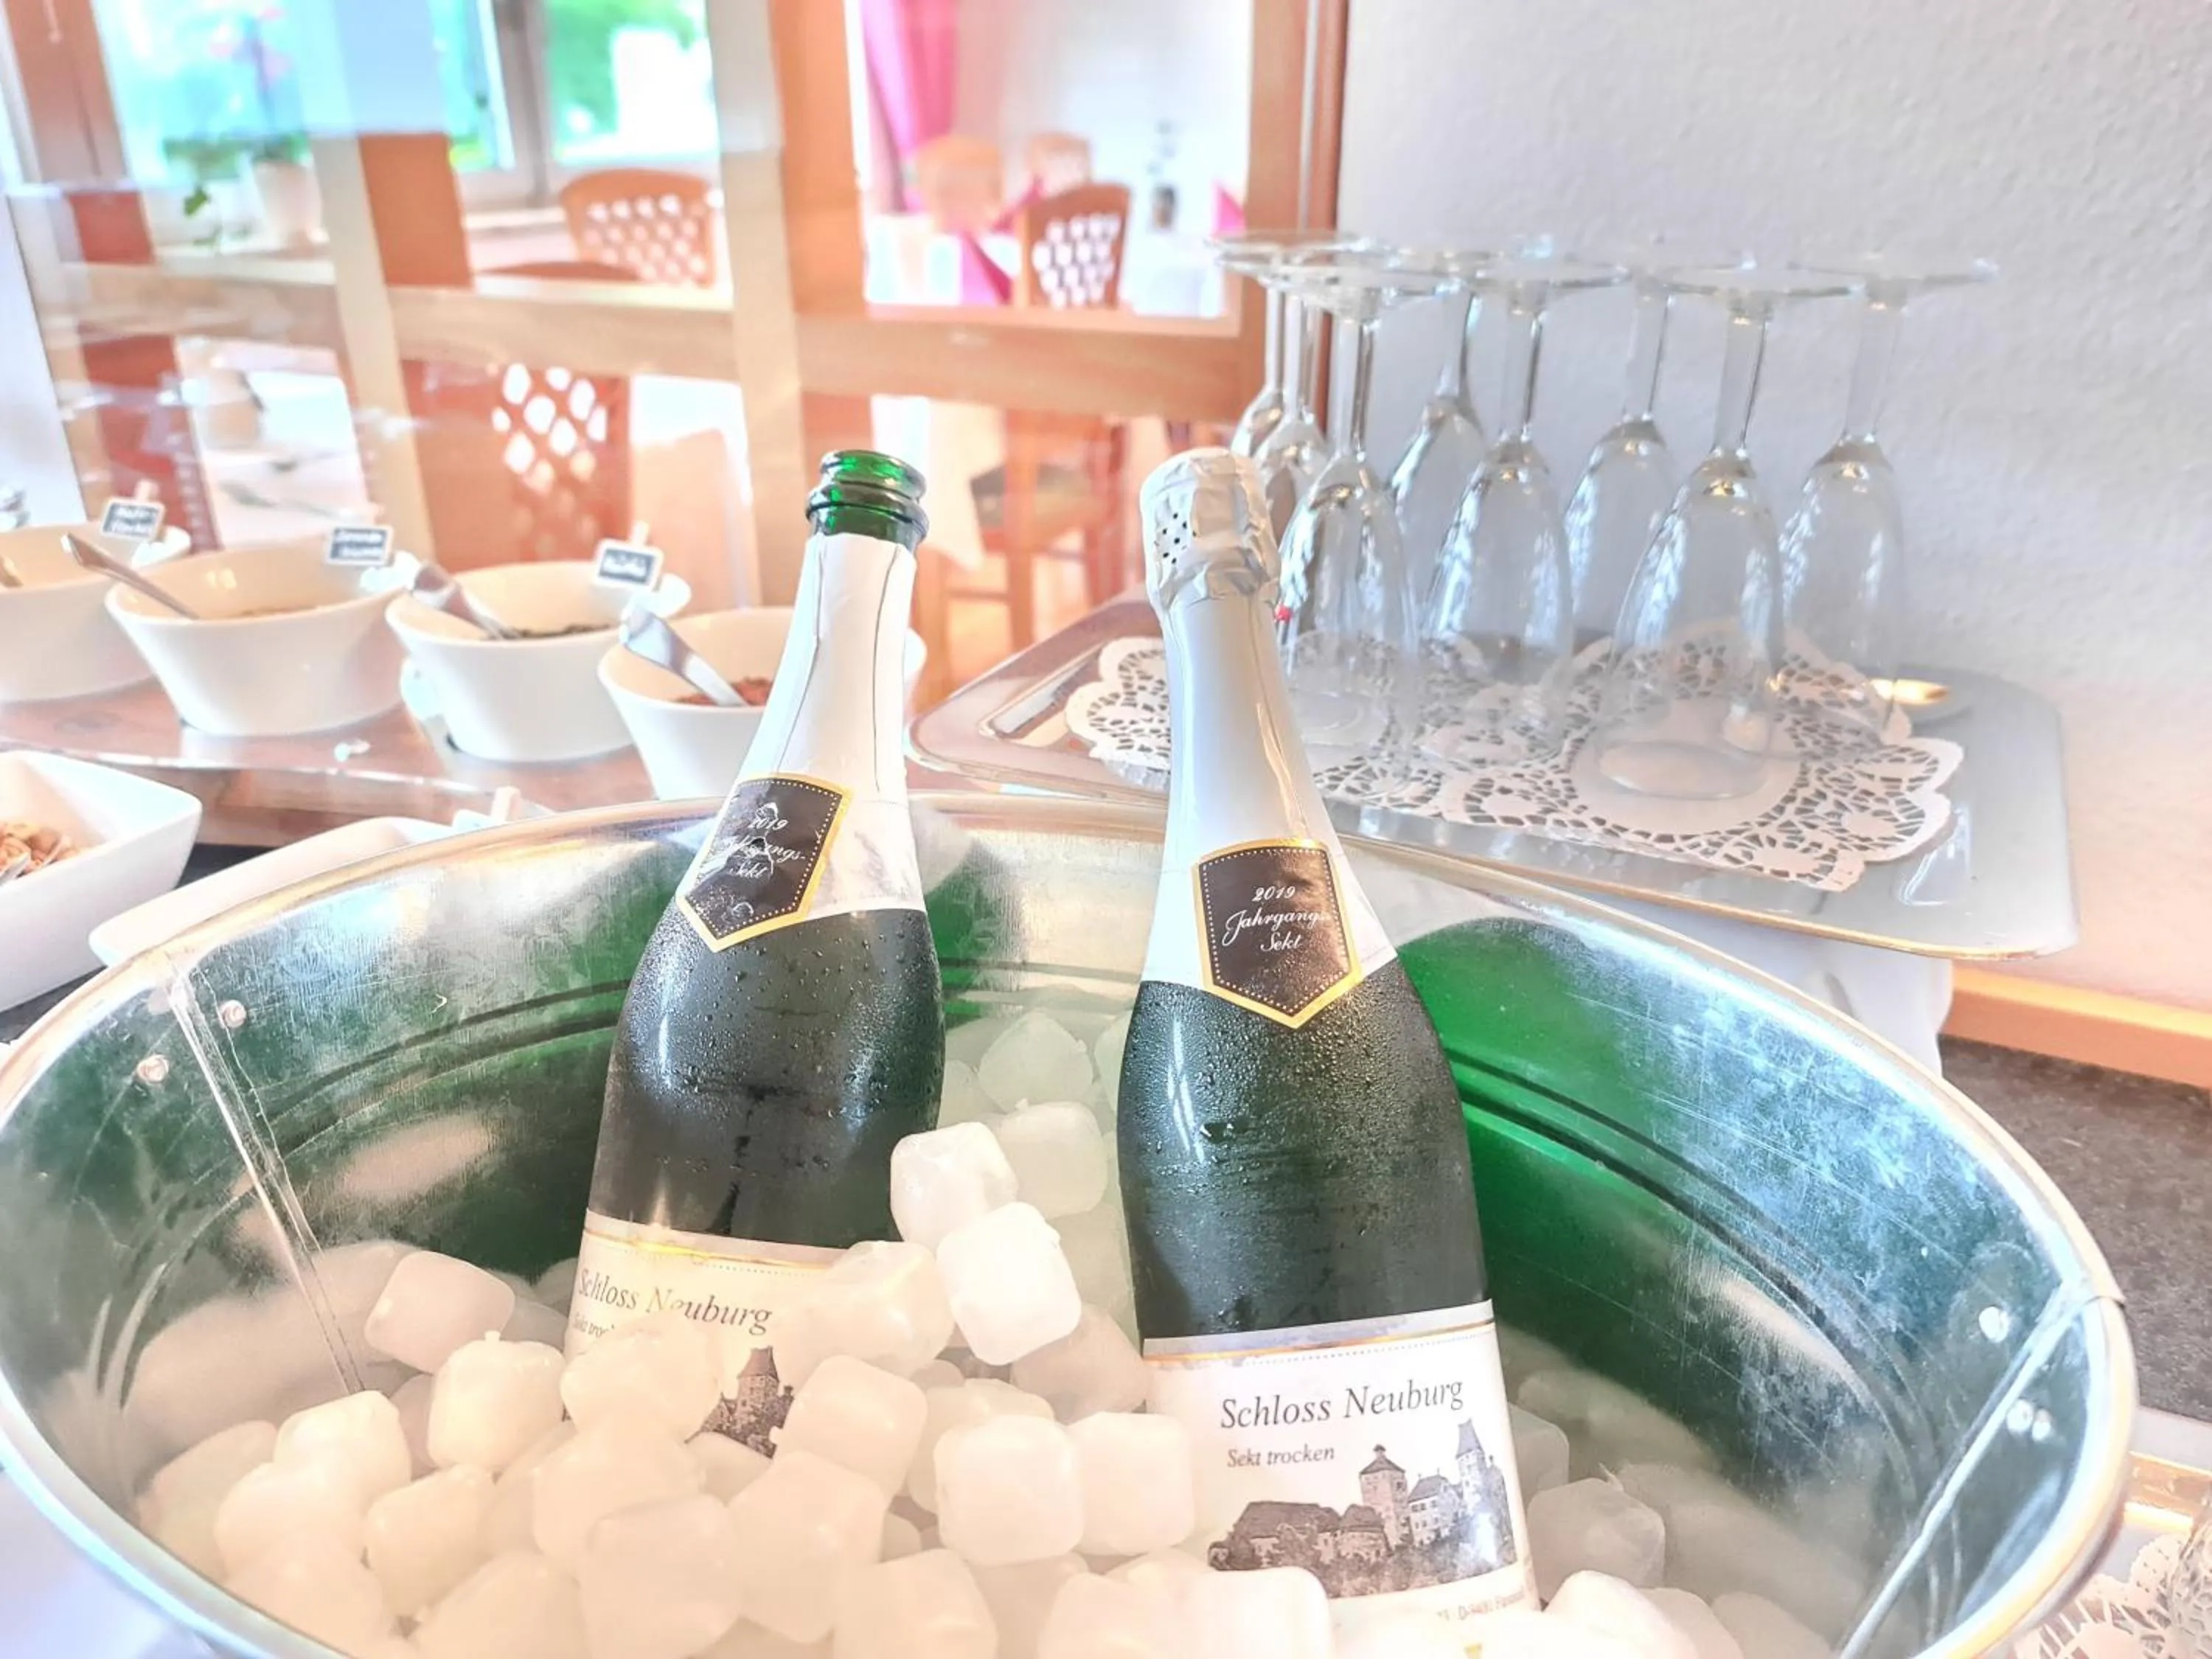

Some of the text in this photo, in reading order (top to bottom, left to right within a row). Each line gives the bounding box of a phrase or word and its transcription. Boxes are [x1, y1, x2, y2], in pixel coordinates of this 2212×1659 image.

[747, 816, 789, 831] 2019
[1251, 886, 1296, 902] 2019
[1222, 907, 1331, 947] Jahrgang
[1260, 931, 1302, 952] Sekt
[578, 1267, 773, 1336] Schloss Neuburg
[1220, 1379, 1464, 1429] Schloss Neuburg
[1227, 1443, 1335, 1467] Sekt trocken
